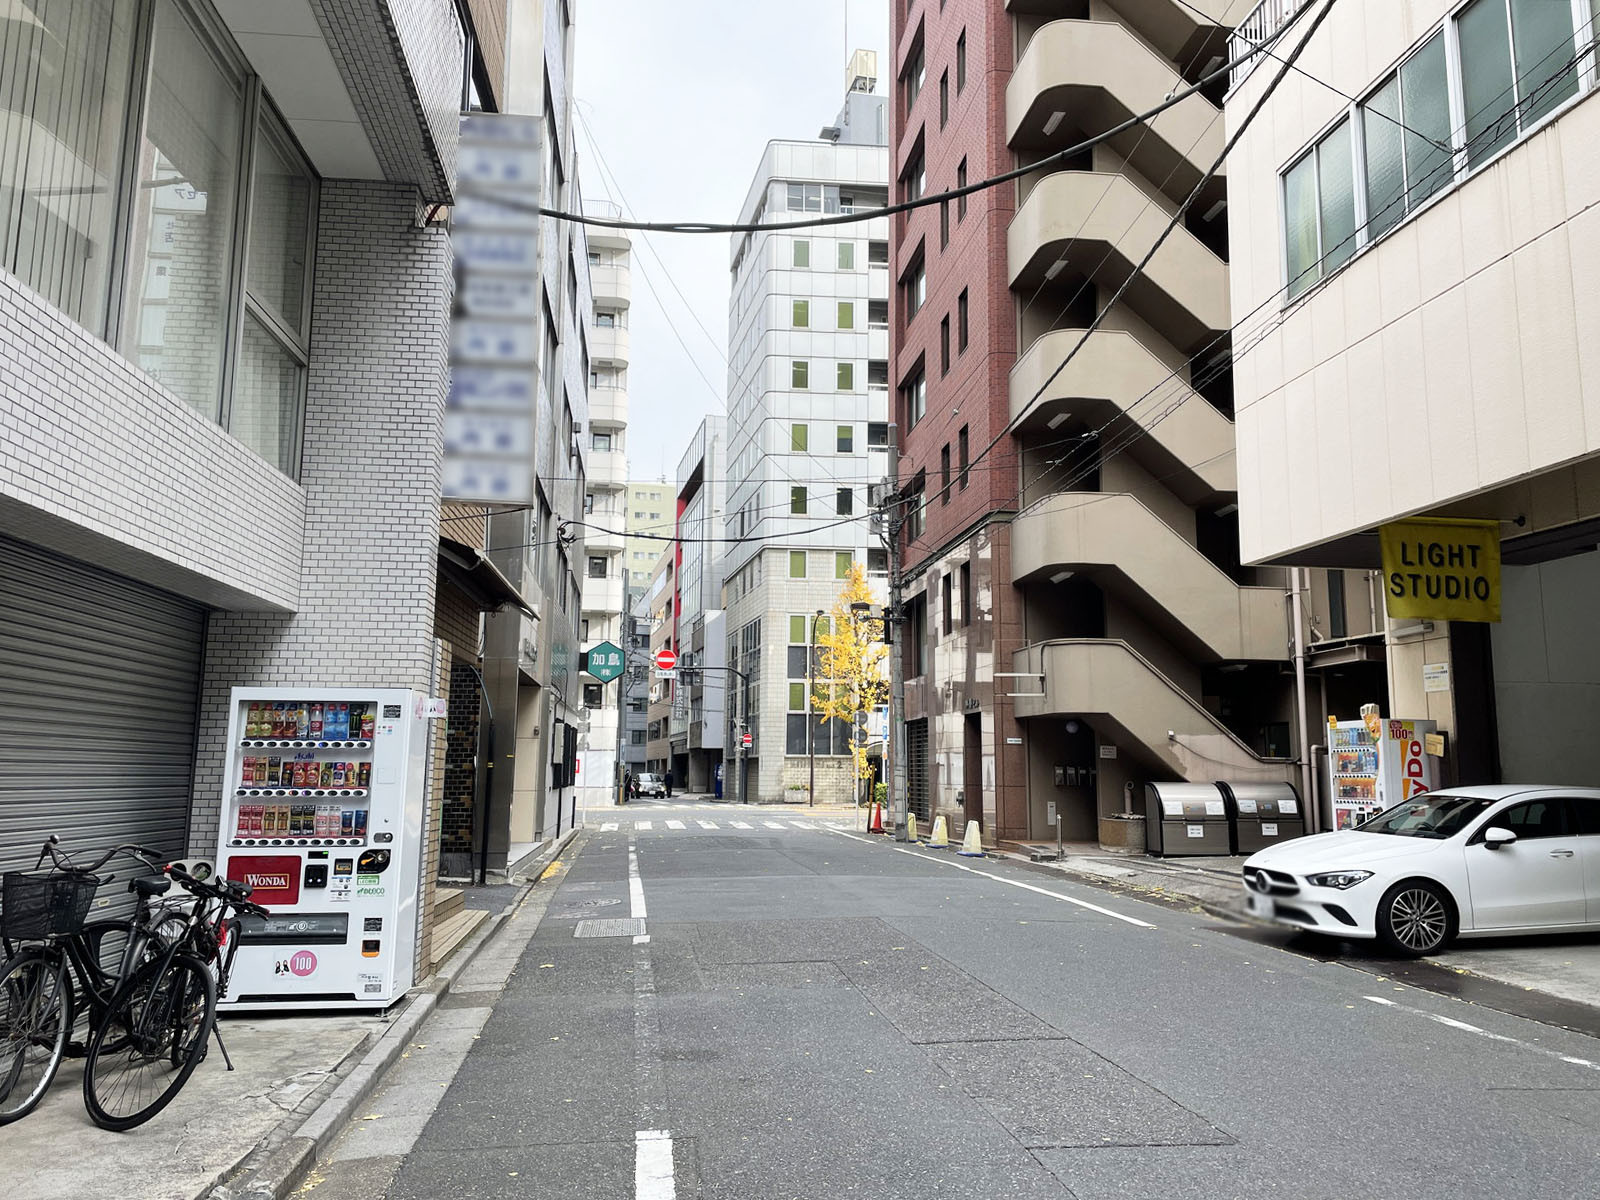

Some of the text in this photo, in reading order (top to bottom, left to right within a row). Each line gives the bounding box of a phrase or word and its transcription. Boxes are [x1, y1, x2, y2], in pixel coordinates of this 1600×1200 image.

[1401, 541, 1481, 569] LIGHT
[1390, 572, 1490, 602] STUDIO
[592, 652, 620, 666] 加島
[1407, 740, 1429, 796] yDo
[246, 873, 287, 887] WONDA
[293, 957, 312, 971] 100
